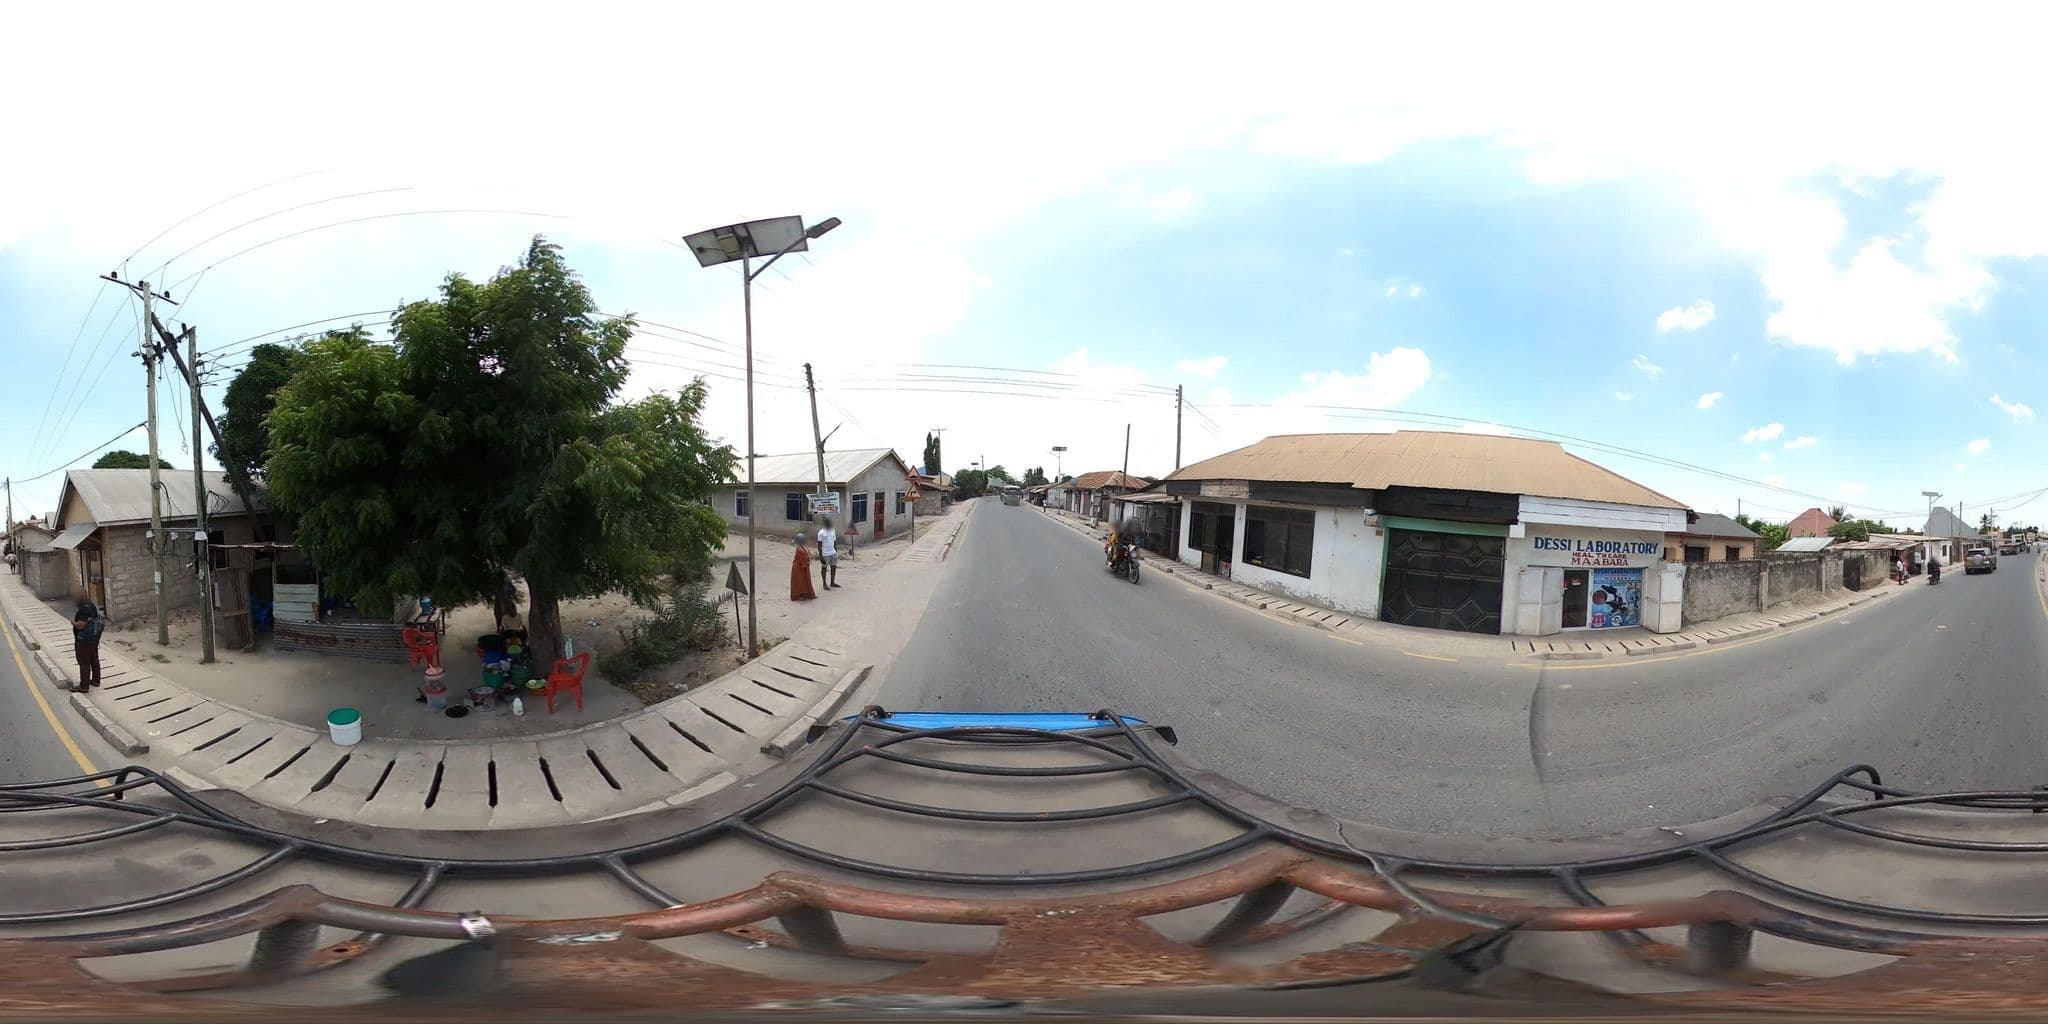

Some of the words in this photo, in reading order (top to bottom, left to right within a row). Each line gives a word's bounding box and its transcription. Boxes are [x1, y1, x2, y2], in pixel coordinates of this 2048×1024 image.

[1534, 537, 1571, 551] DESSI
[1576, 540, 1658, 554] LABORATORY
[1571, 558, 1629, 566] MAABARA
